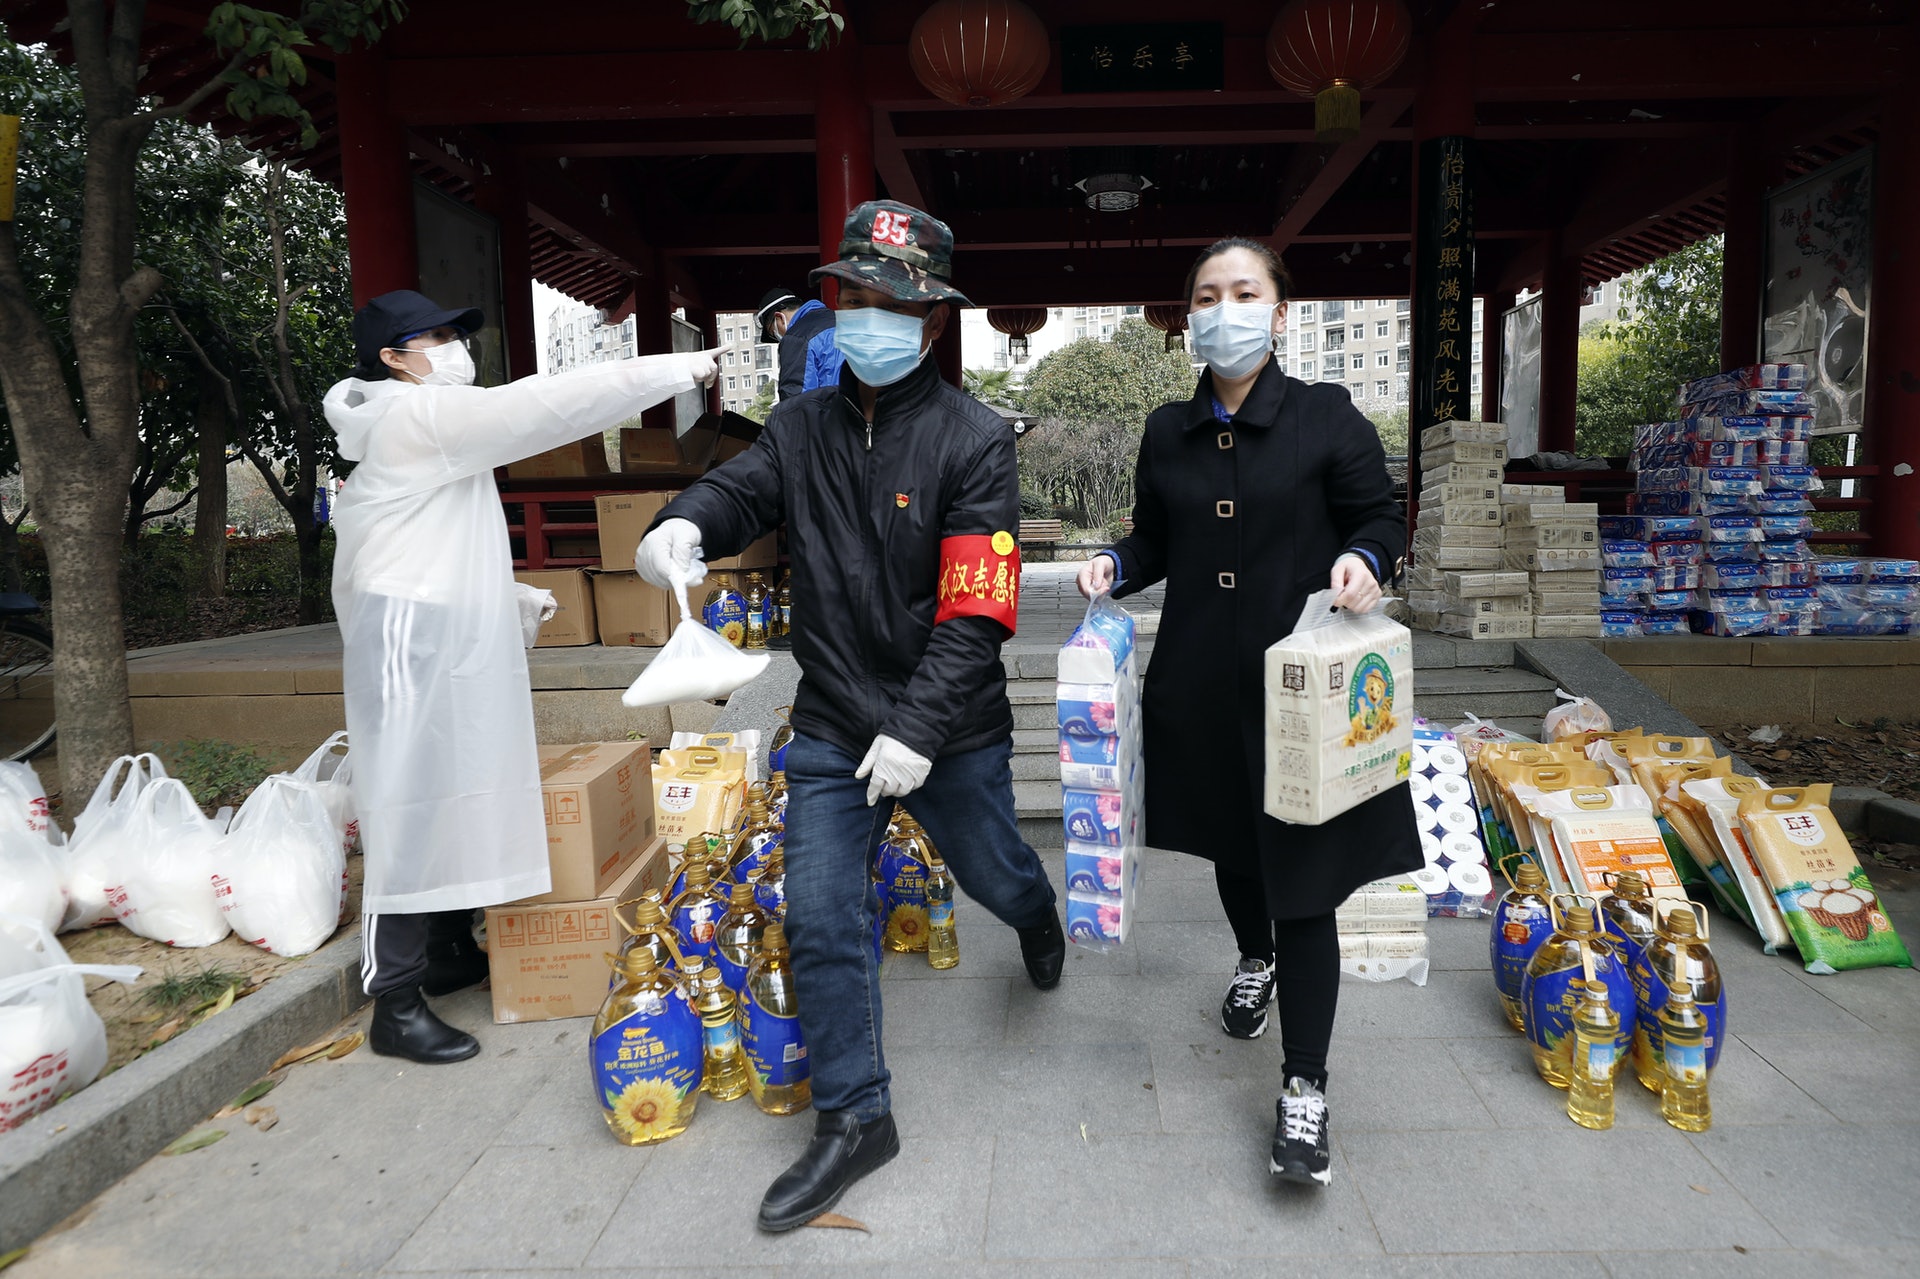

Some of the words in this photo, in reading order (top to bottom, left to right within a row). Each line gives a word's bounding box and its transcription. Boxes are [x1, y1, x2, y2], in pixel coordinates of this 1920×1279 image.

[1090, 41, 1194, 70] 怡乐亭
[873, 210, 908, 245] 35
[665, 785, 693, 799] 五丰
[1783, 814, 1815, 831] 五丰
[563, 913, 574, 926] 4
[617, 1041, 665, 1061] 金龙鱼
